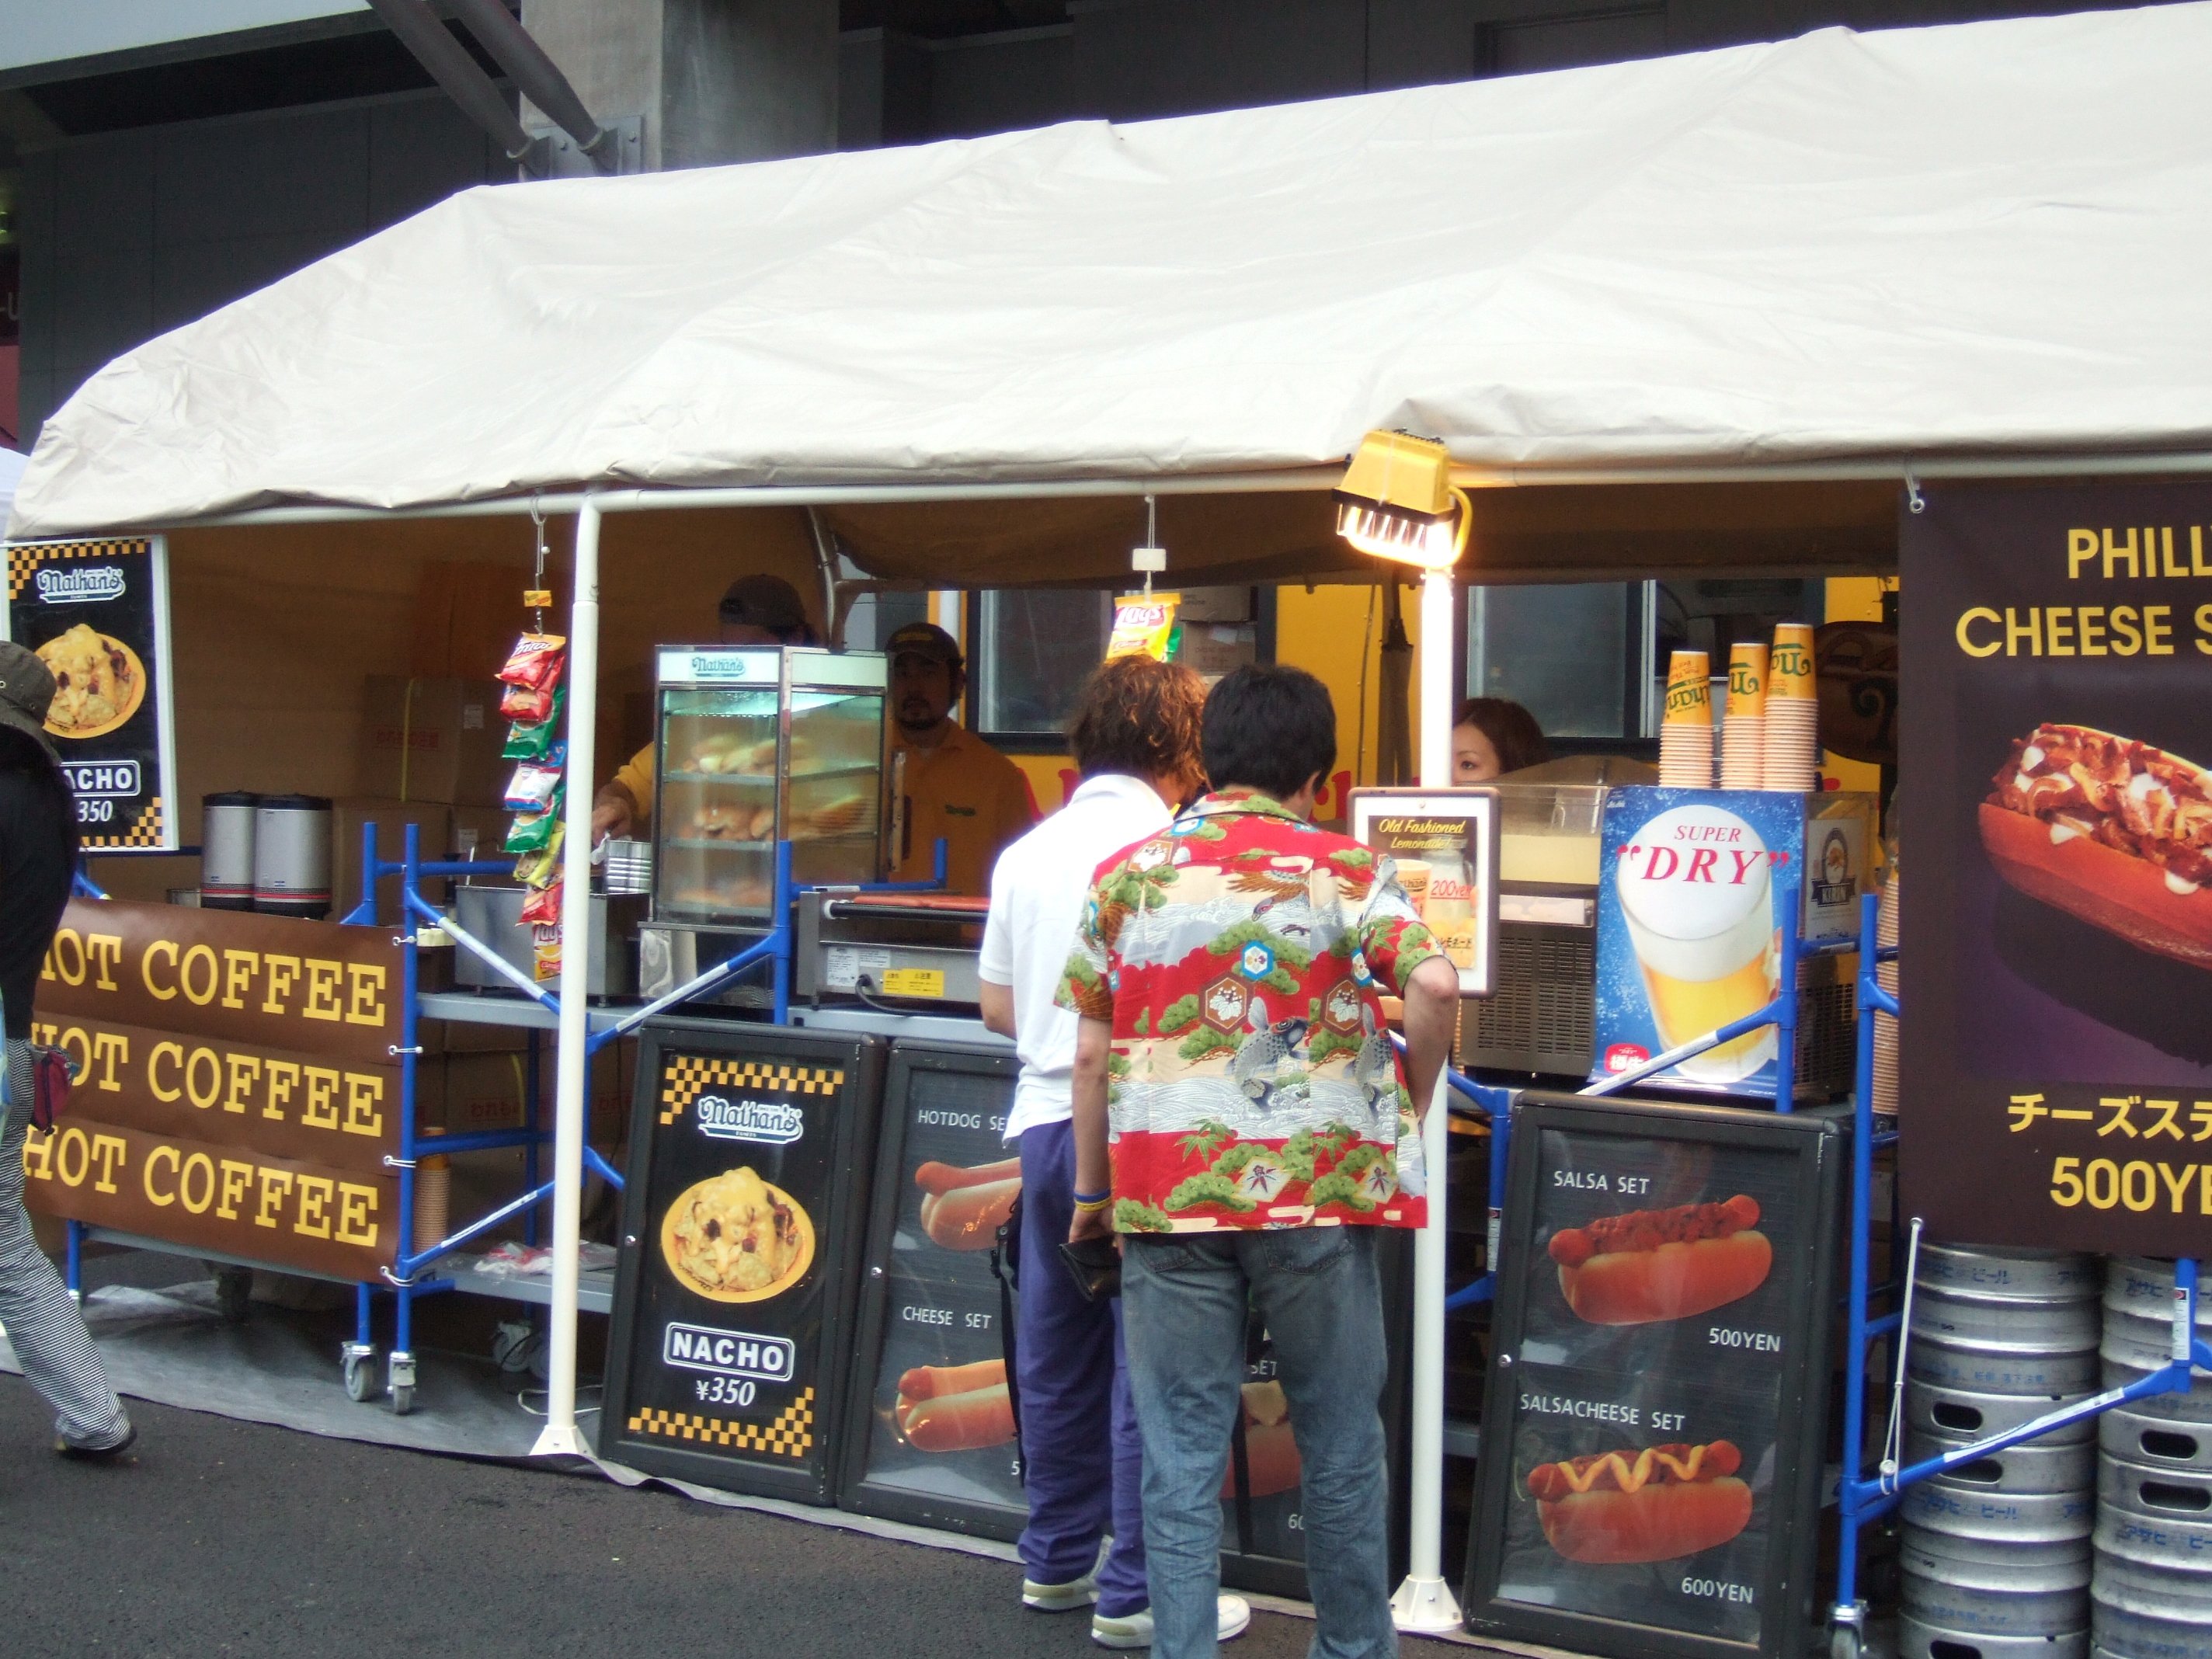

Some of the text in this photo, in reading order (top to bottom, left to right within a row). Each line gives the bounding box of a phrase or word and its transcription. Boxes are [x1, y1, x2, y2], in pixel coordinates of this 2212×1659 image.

[2068, 525, 2212, 579] PHILL
[1956, 605, 2175, 658] CHEESE
[78, 800, 113, 823] 350
[1379, 818, 1467, 833] Old Fashioned
[1674, 825, 1742, 843] SUPER
[141, 940, 386, 1027] COFFEE
[148, 1042, 384, 1138] COFFEE
[699, 1097, 802, 1132] Nathan's
[917, 1109, 1008, 1132] HOTDOG SE
[23, 1122, 378, 1247] HOT COFFEE
[1553, 1170, 1650, 1195] SALSA SET
[903, 1306, 992, 1330] CHEESE SET
[672, 1331, 784, 1372] NACHO
[1709, 1327, 1782, 1352] 500YEN
[695, 1376, 756, 1407] ¥350
[1520, 1393, 1685, 1432] SALSACHEESE SET
[1681, 1577, 1754, 1604] 600YEN
